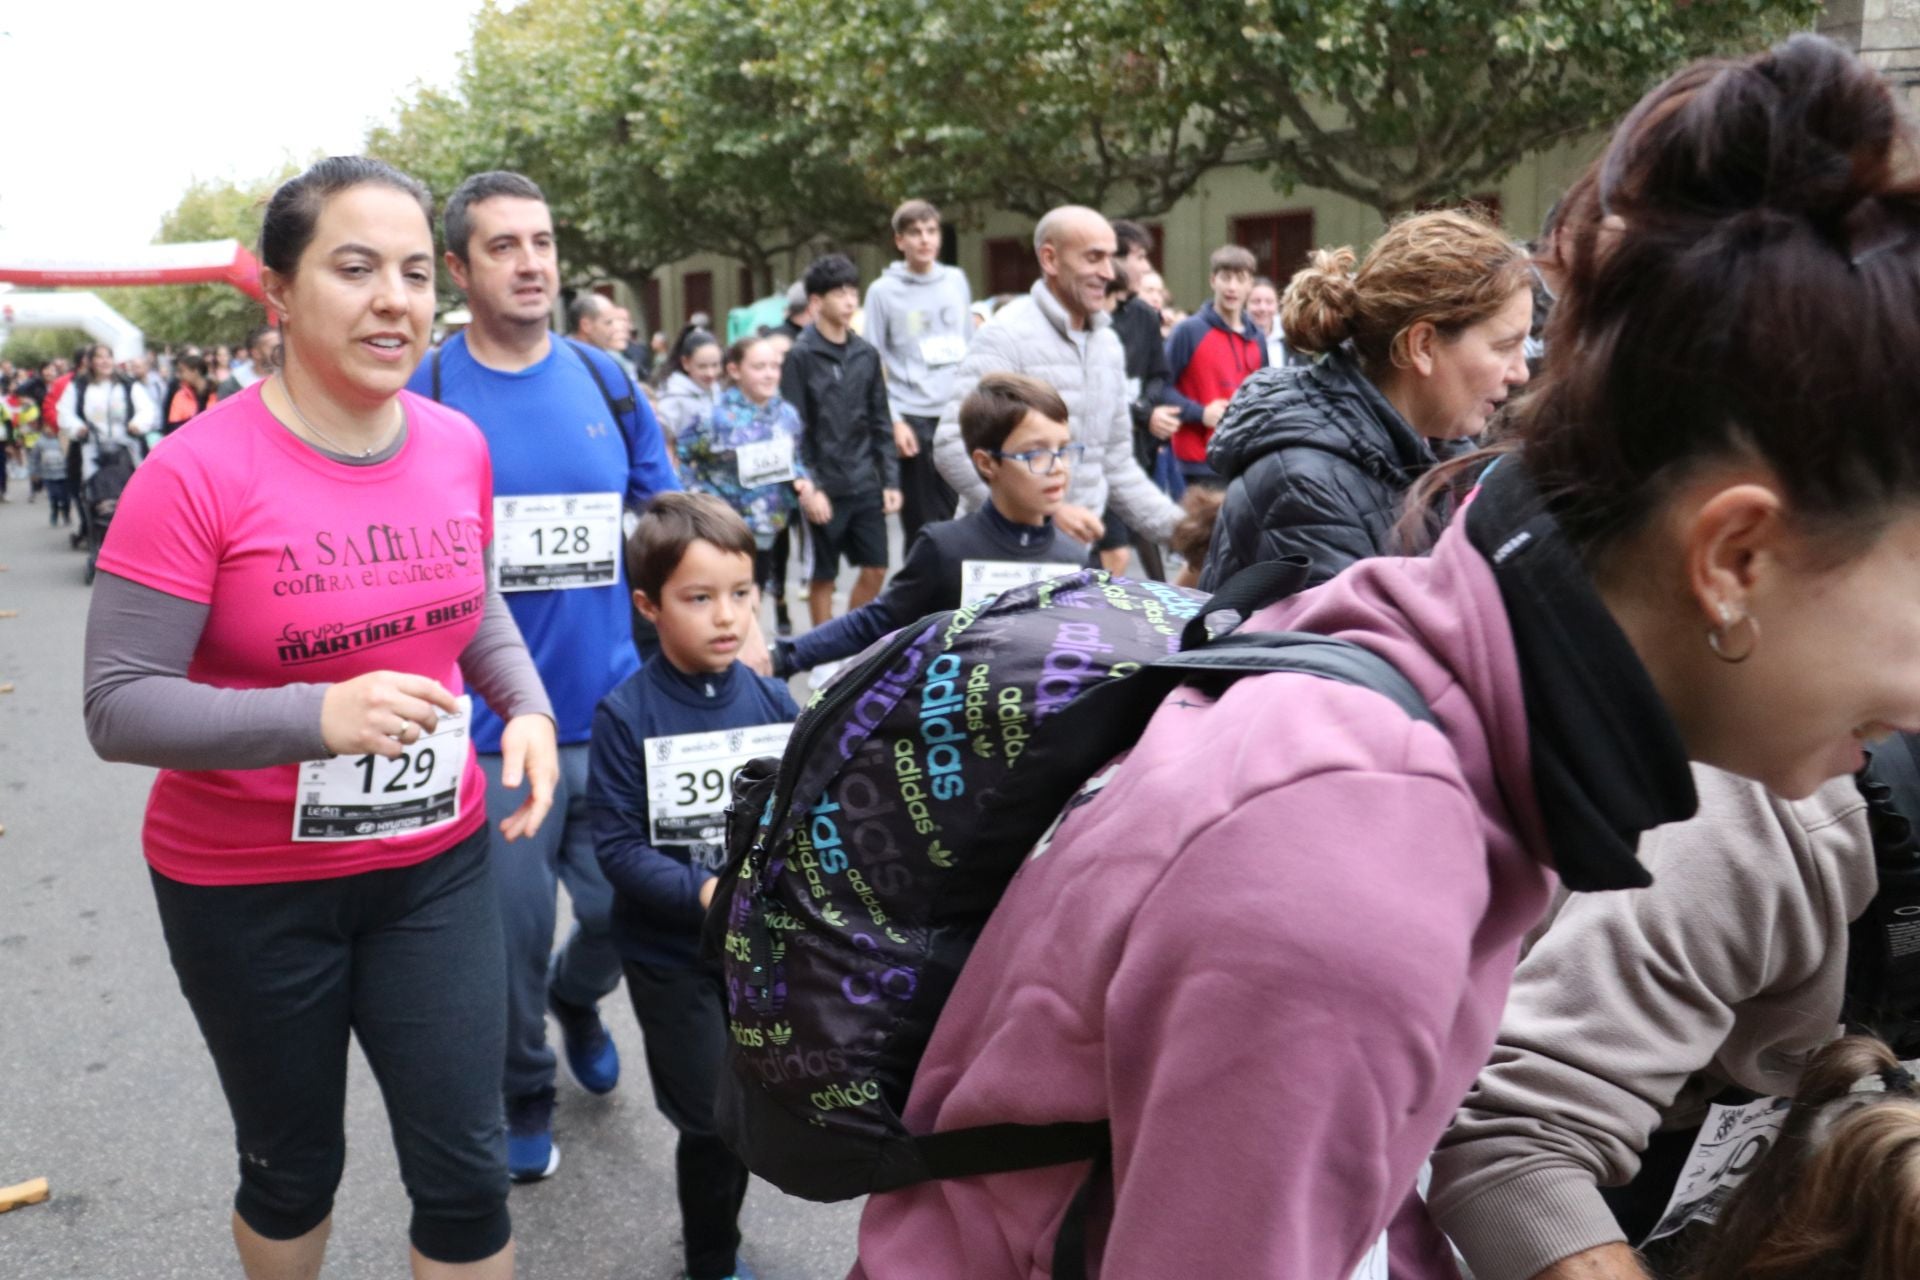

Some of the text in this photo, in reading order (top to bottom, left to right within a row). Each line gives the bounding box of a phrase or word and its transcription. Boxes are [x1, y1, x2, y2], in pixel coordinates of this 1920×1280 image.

[529, 526, 590, 556] 128
[277, 615, 417, 662] MARTÍNEZ
[281, 621, 345, 645] Grupo
[965, 663, 991, 731] adidas
[1034, 622, 1115, 720] adida
[918, 653, 968, 800] adidas
[354, 748, 435, 794] 129
[893, 738, 935, 835] adidas
[846, 868, 888, 926] adidas
